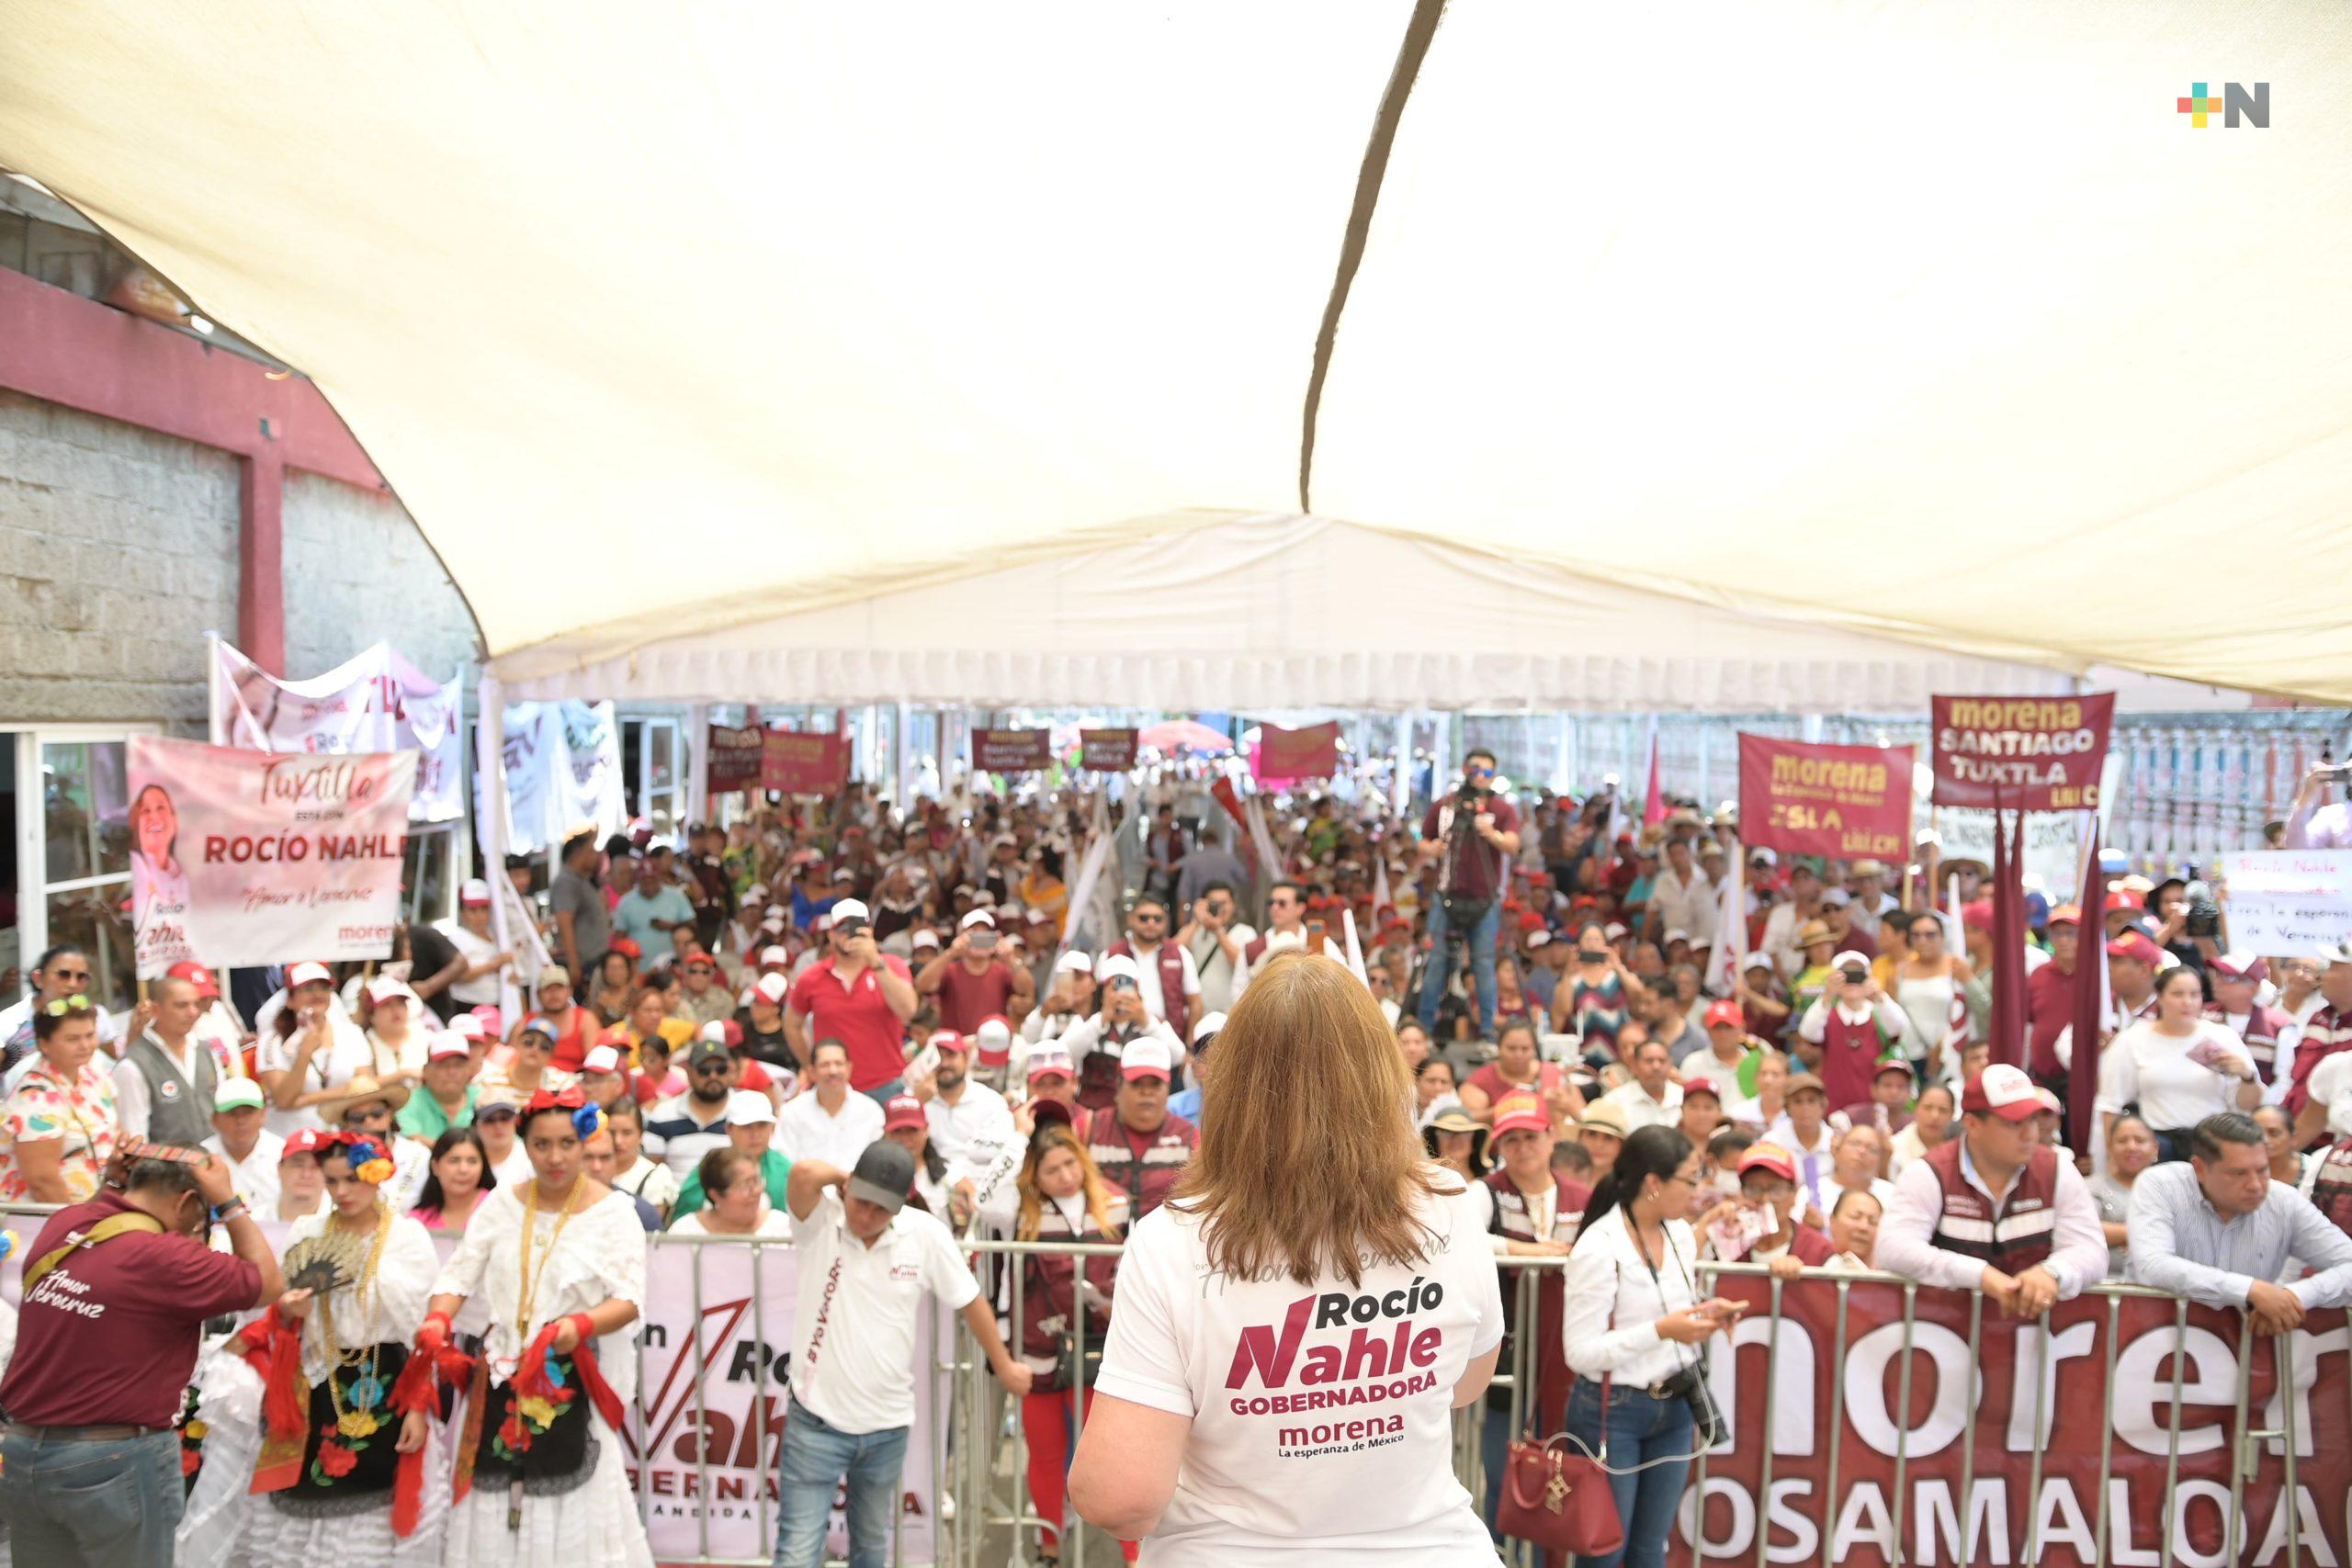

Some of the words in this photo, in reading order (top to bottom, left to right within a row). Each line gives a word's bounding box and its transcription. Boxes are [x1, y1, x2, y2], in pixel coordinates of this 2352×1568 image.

[1951, 699, 2082, 729] morena
[1939, 728, 2094, 756] SANTIAGO
[1772, 753, 1887, 792] morena
[1950, 754, 2066, 784] TUXTLA
[205, 829, 308, 863] ROCÍO
[44, 1269, 91, 1294] Amor
[25, 1280, 105, 1318] Veracruz
[1225, 1293, 1442, 1390] Nahle
[1230, 1371, 1437, 1416] GOBERNADORA
[1279, 1414, 1404, 1446] morena
[1279, 1449, 1291, 1458] La
[1294, 1445, 1349, 1459] esperanza
[1352, 1441, 1365, 1451] de
[1368, 1434, 1404, 1449] México
[1663, 1476, 2352, 1568] OSAMALOA
